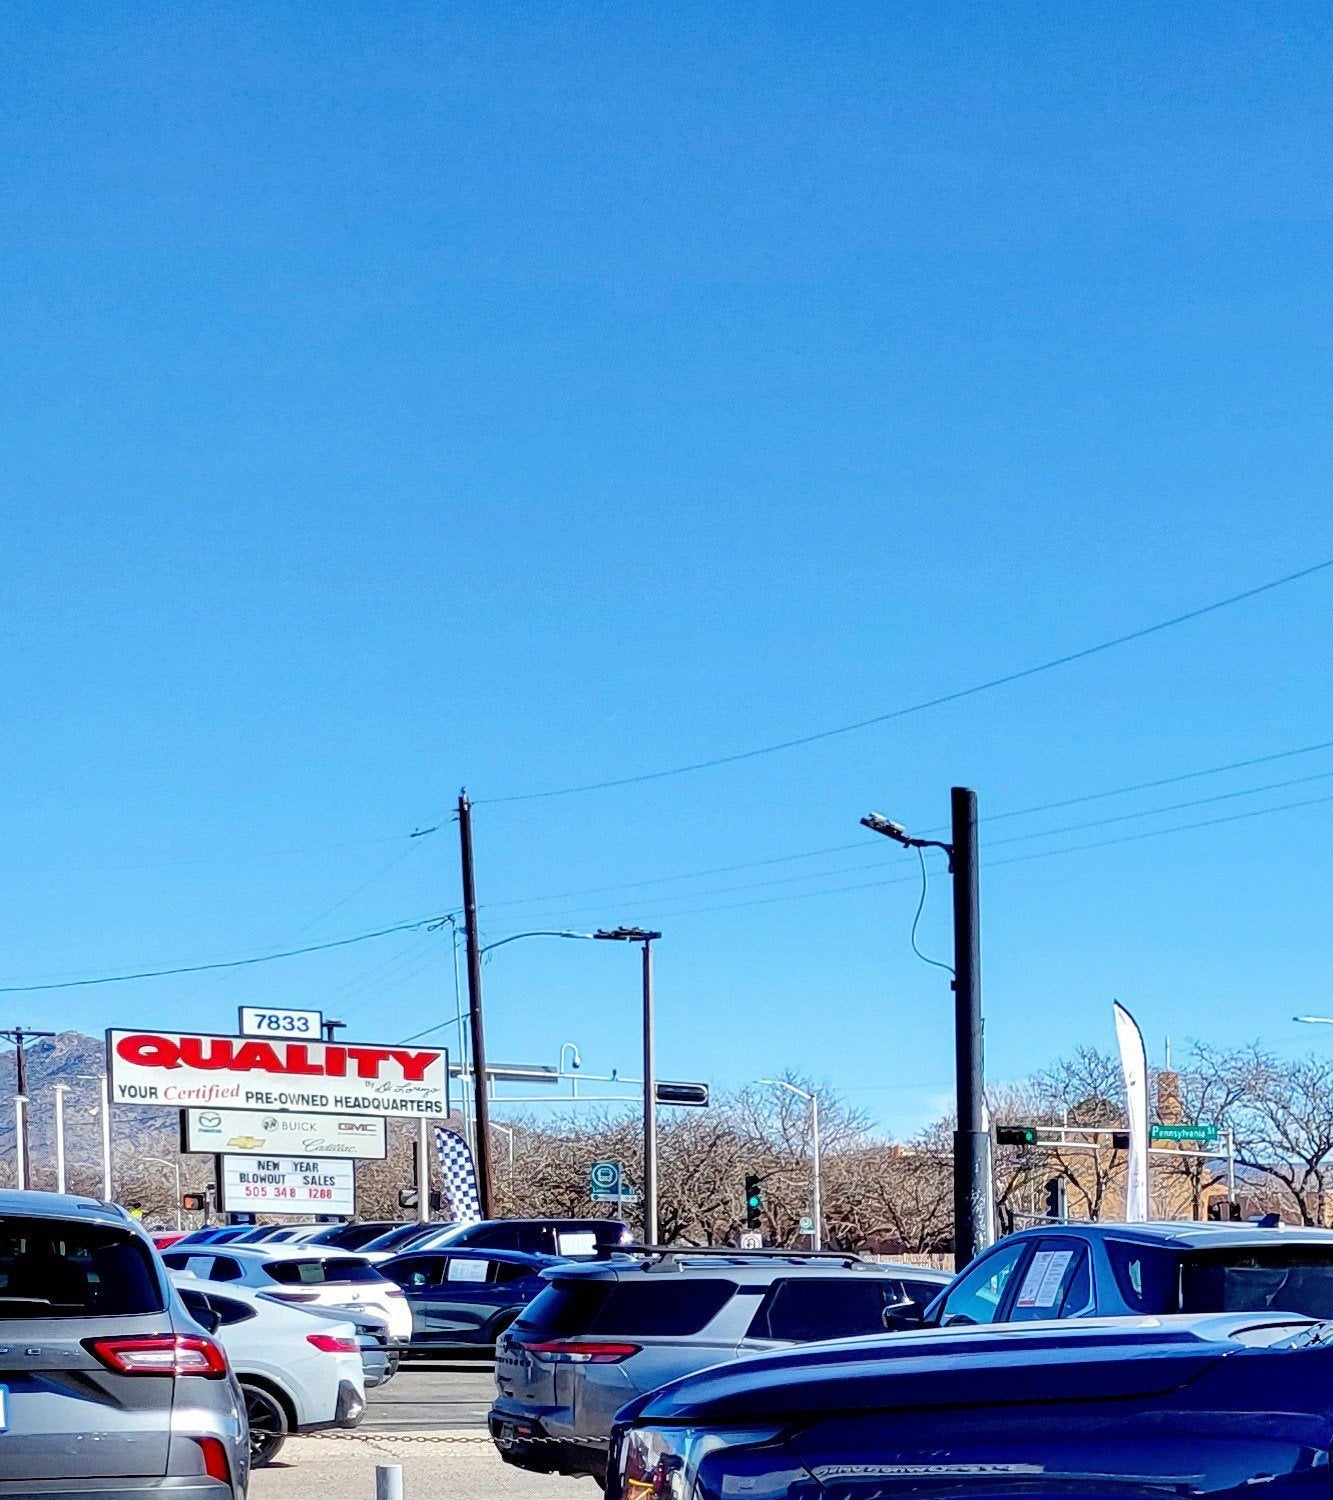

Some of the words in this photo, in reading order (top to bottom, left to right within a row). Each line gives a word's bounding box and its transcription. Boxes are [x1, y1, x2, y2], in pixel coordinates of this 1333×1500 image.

[254, 1013, 310, 1032] 7833
[116, 1034, 441, 1081] QUALITY
[118, 1084, 158, 1099] YOUR
[163, 1083, 240, 1103] Certified
[245, 1091, 329, 1108] PRE-OWNED
[334, 1096, 443, 1114] HEADQUARTERS
[282, 1121, 317, 1132] BUICK
[338, 1122, 377, 1132] GMC
[257, 1160, 280, 1171] NEW
[293, 1162, 319, 1173] YEAR
[239, 1172, 286, 1185] BLOWOUT
[303, 1175, 336, 1187] SALES
[245, 1186, 267, 1197] 505
[274, 1187, 297, 1198] 348
